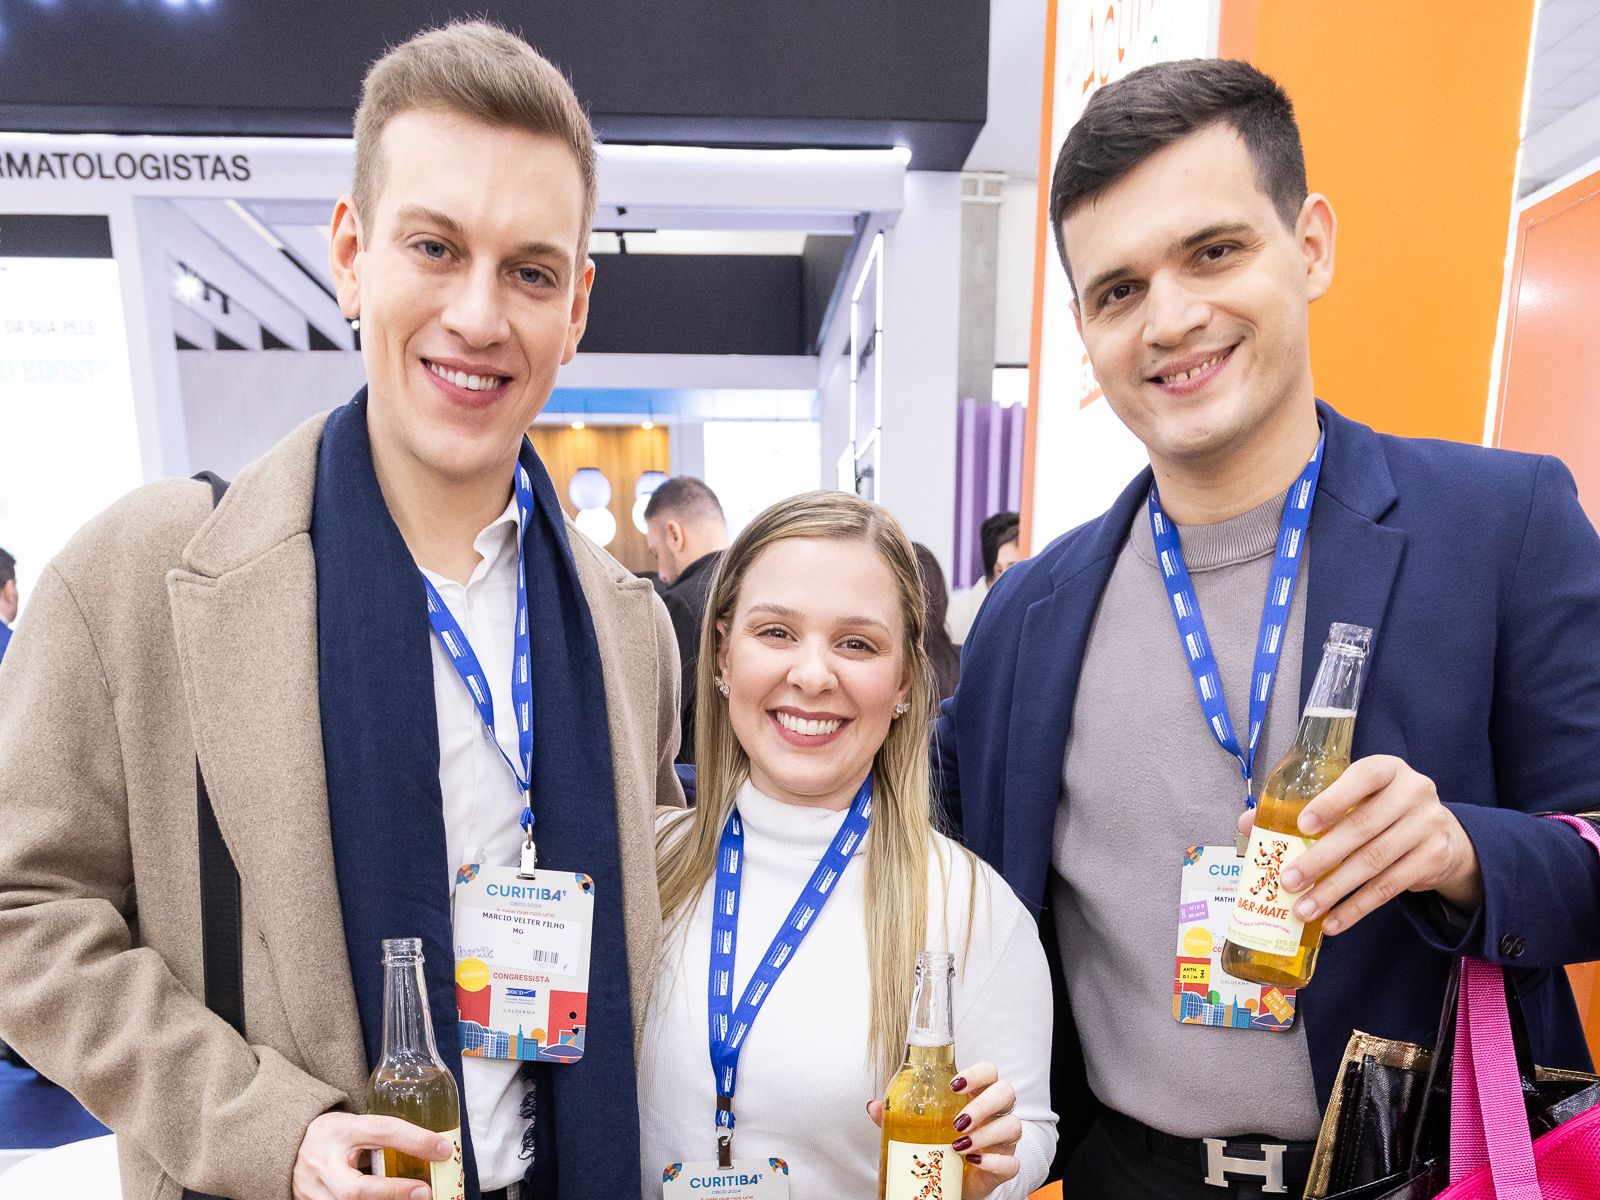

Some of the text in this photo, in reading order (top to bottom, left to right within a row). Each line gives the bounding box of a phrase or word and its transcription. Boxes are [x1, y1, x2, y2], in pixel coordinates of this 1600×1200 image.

[0, 152, 251, 181] MATOLOGISTAS
[63, 319, 97, 335] PELE
[482, 912, 565, 930] MARCIO VELTER FILHO
[512, 927, 524, 935] MG
[493, 972, 550, 983] CONGRESSISTA
